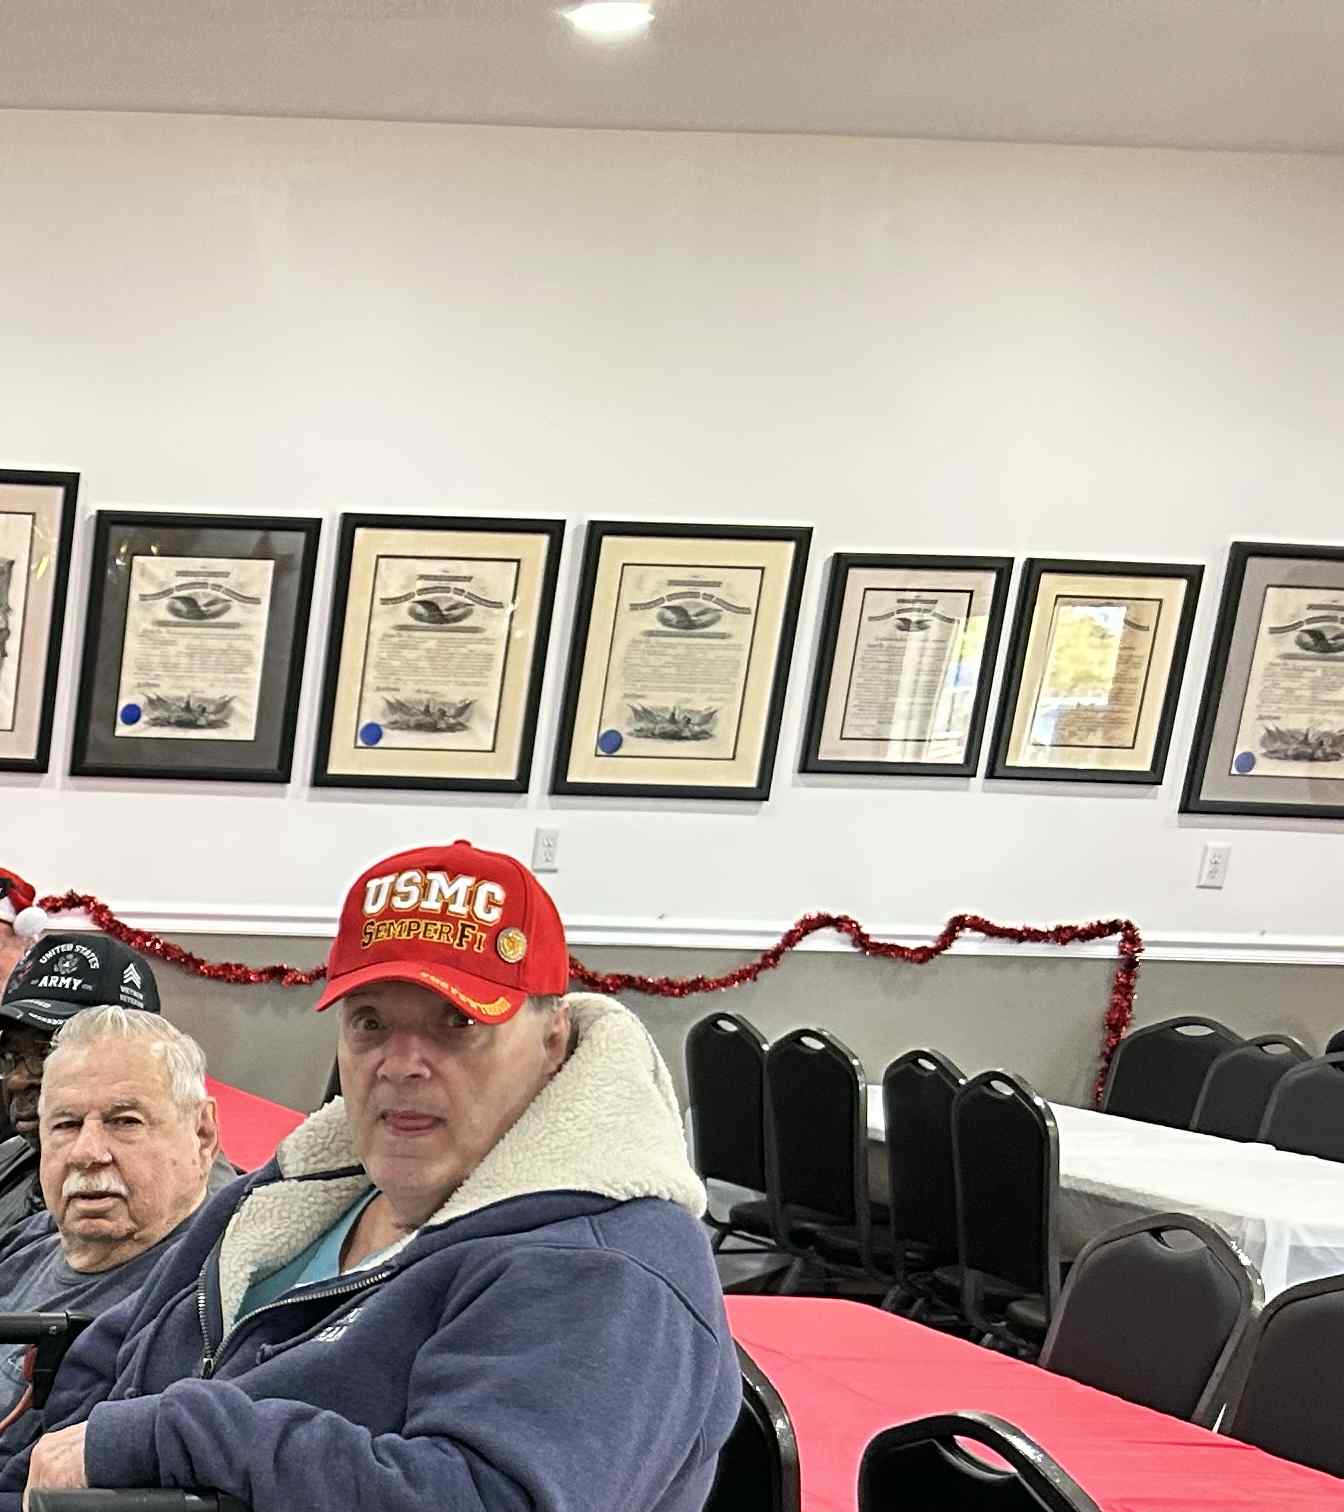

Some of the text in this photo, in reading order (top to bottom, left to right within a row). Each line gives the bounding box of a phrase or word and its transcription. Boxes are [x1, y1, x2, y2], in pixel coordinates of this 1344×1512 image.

[363, 869, 506, 925] USMC
[362, 918, 487, 952] SEMPER FI
[39, 943, 100, 969] UNITED STATES
[38, 975, 83, 991] ARMY
